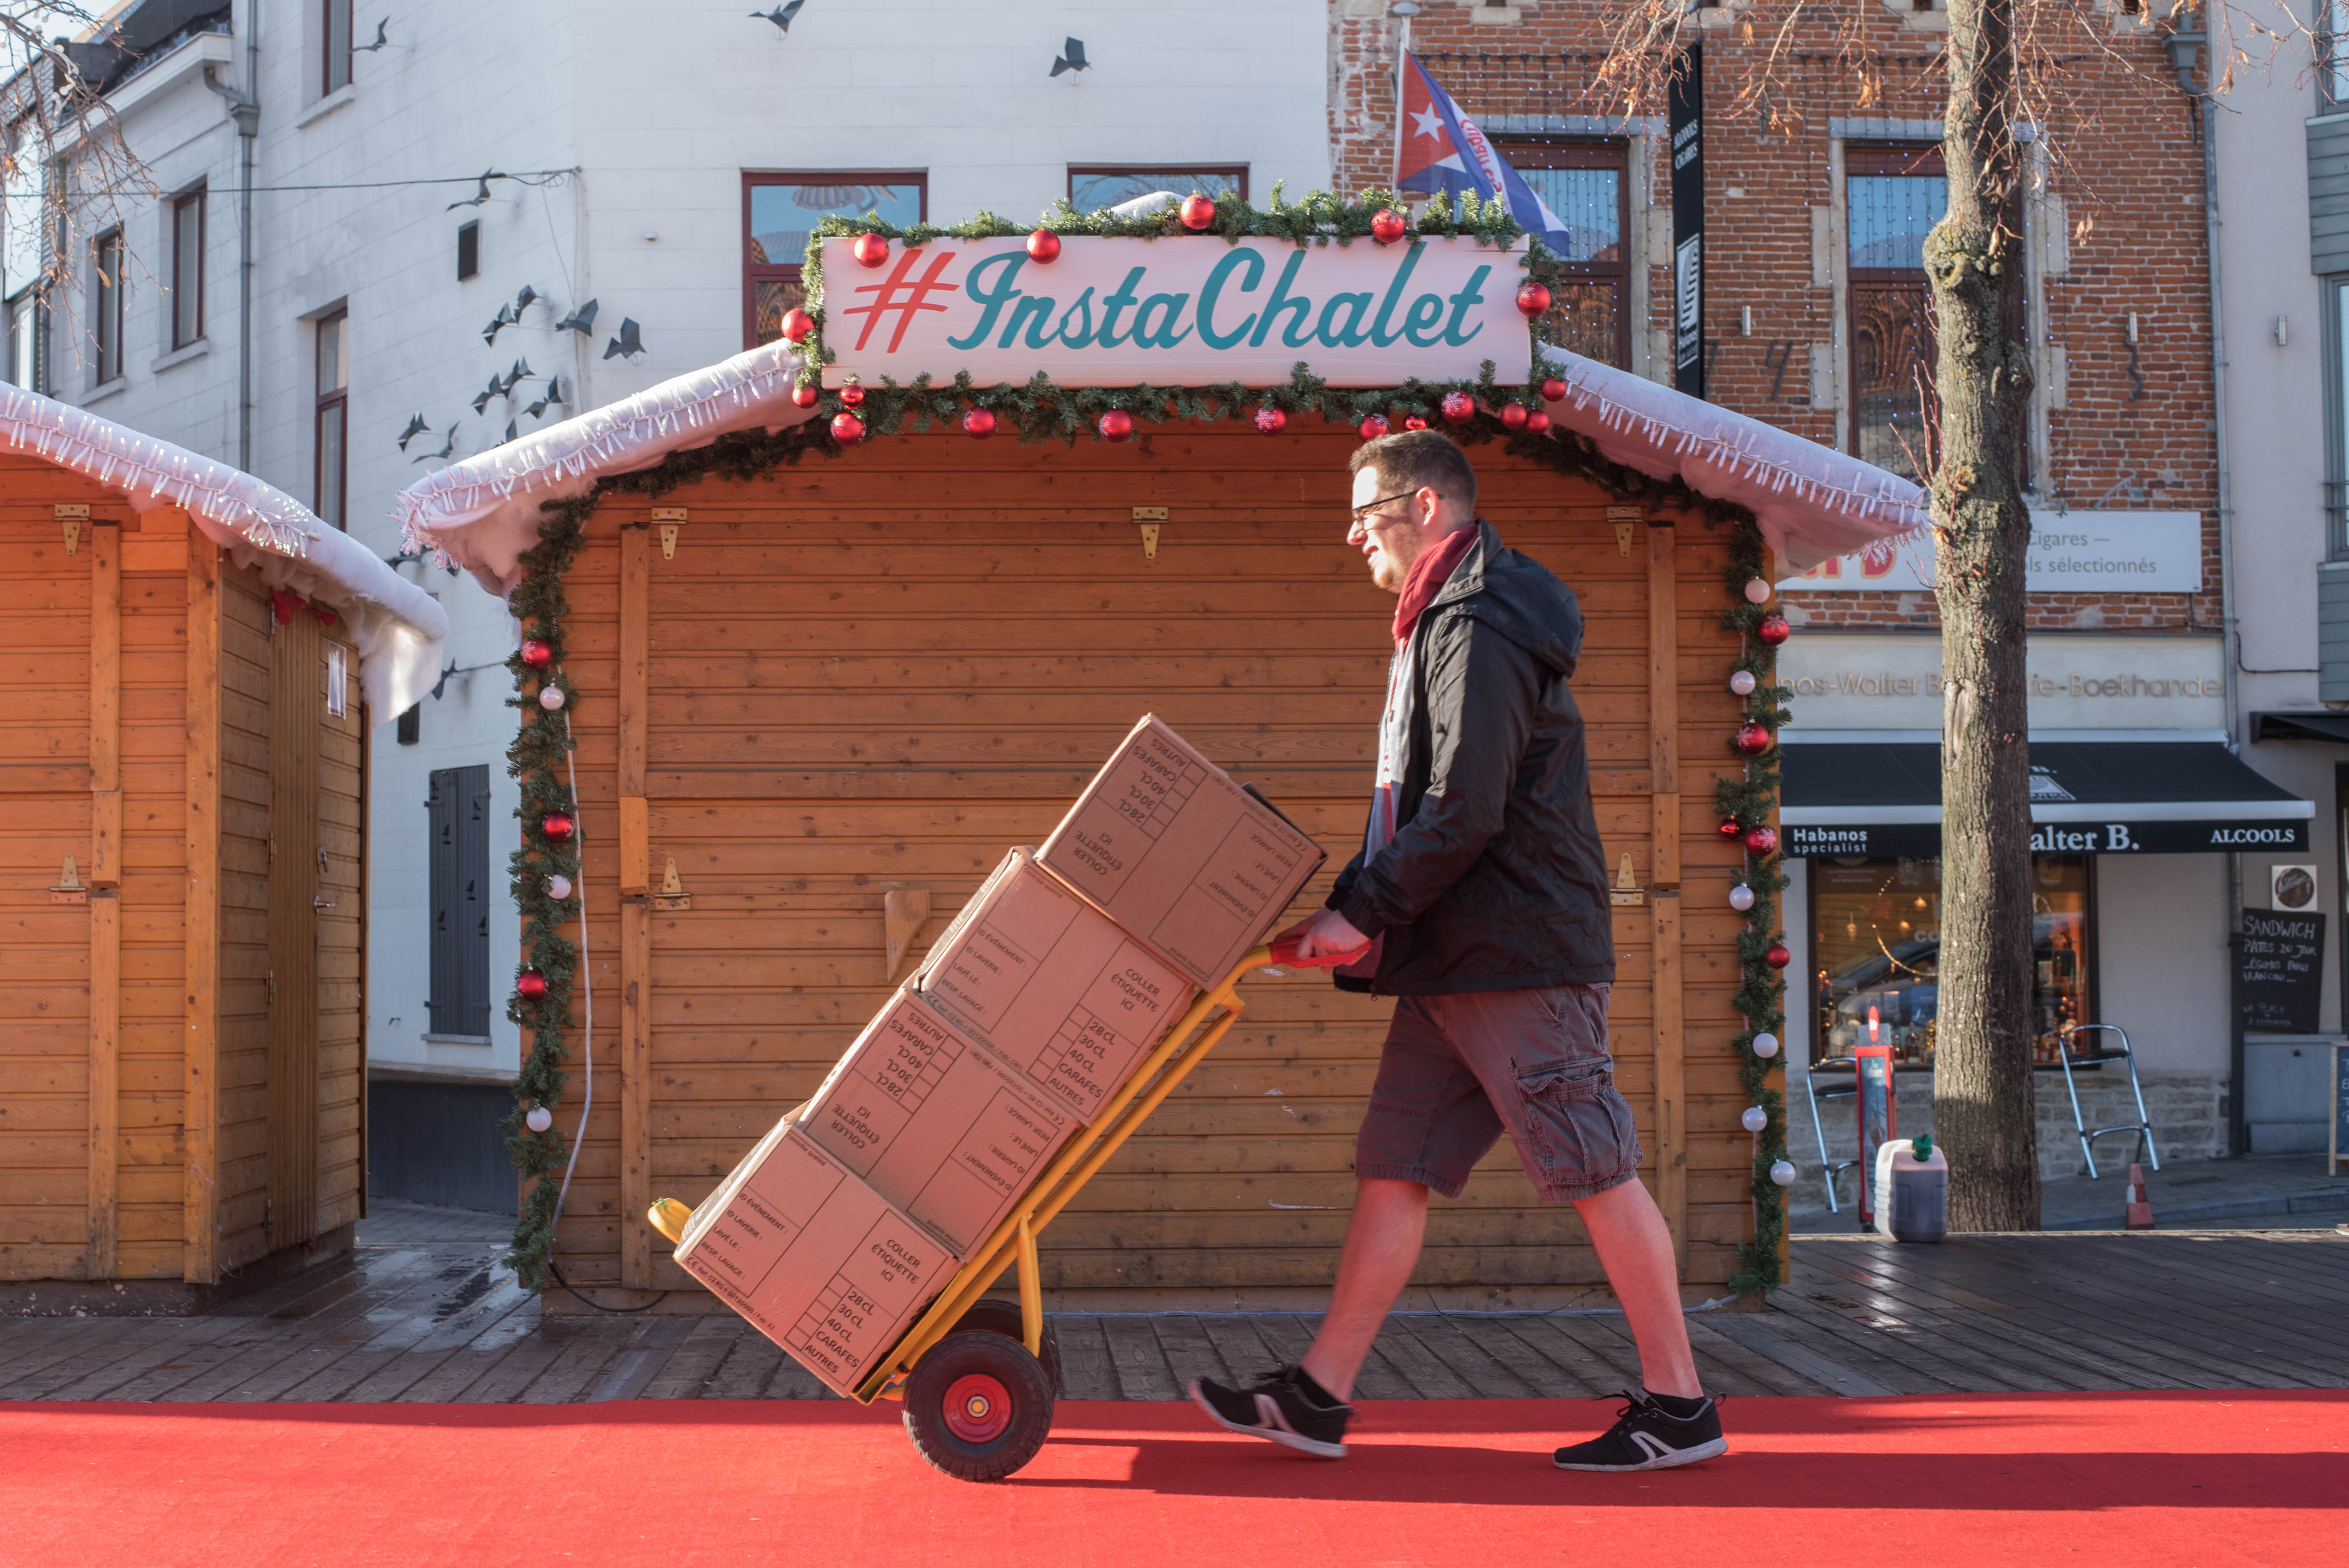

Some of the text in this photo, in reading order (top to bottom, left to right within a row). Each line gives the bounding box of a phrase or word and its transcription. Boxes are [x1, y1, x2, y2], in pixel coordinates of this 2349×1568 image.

[843, 242, 1492, 353] #InstaChalet
[2048, 557, 2157, 573] sélectionnés
[1132, 746, 1177, 782] CARAFES
[1151, 739, 1187, 767] AUTRES
[1099, 833, 1113, 846] ICI
[1793, 827, 1868, 842] Habanos
[2030, 824, 2140, 851] alter B.
[2210, 829, 2295, 843] ALCOOLS
[1073, 847, 1107, 875] COLLER
[1075, 831, 1123, 870] ÉTIQUETTE
[1794, 843, 1867, 855] specialist
[2244, 915, 2315, 939] SANDWICH
[1111, 973, 1159, 1012] ÉTIQUETTE
[1125, 969, 1160, 997] COLLER
[1120, 998, 1135, 1011] ICI
[889, 1020, 934, 1056] CARAFES
[908, 1012, 944, 1041] AUTRES
[1049, 1078, 1084, 1106] AUTRES
[1059, 1063, 1103, 1098] CARAFES
[832, 1104, 880, 1144] ÉTIQUETTE
[857, 1106, 871, 1119] ICI
[831, 1120, 865, 1149] COLLER
[739, 1192, 747, 1201] ID
[726, 1210, 735, 1218] ID
[871, 1244, 919, 1284] ÉTIQUETTE
[887, 1239, 921, 1268] COLLER
[880, 1269, 894, 1282] ICI
[804, 1345, 839, 1373] AUTRES
[816, 1331, 860, 1368] CARAFES
